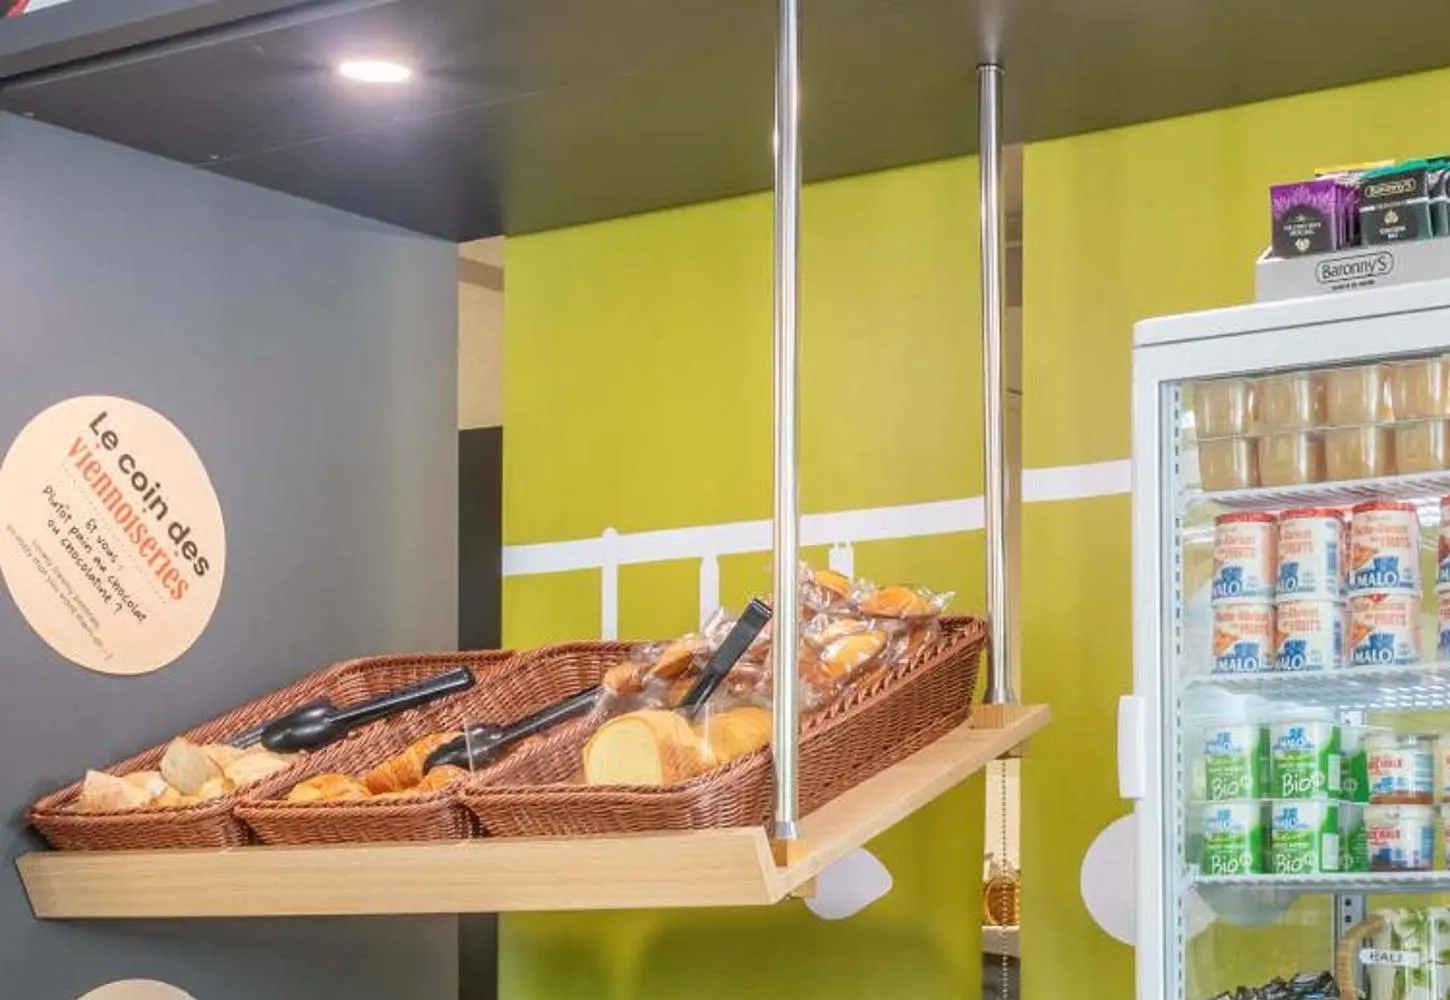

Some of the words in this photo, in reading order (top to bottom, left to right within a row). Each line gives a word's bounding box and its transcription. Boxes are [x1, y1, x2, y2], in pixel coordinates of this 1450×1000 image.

[68, 436, 189, 601] viennoiseries
[88, 411, 119, 451] Le
[118, 453, 169, 521] coin
[167, 521, 210, 577] des
[47, 519, 60, 536] ou
[60, 538, 112, 604] chocolatine
[68, 526, 93, 555] pain
[93, 555, 107, 574] au
[107, 575, 148, 623] chocolat
[1355, 571, 1397, 588] MALO
[1283, 773, 1311, 797] Bio
[1212, 854, 1239, 874] Bio
